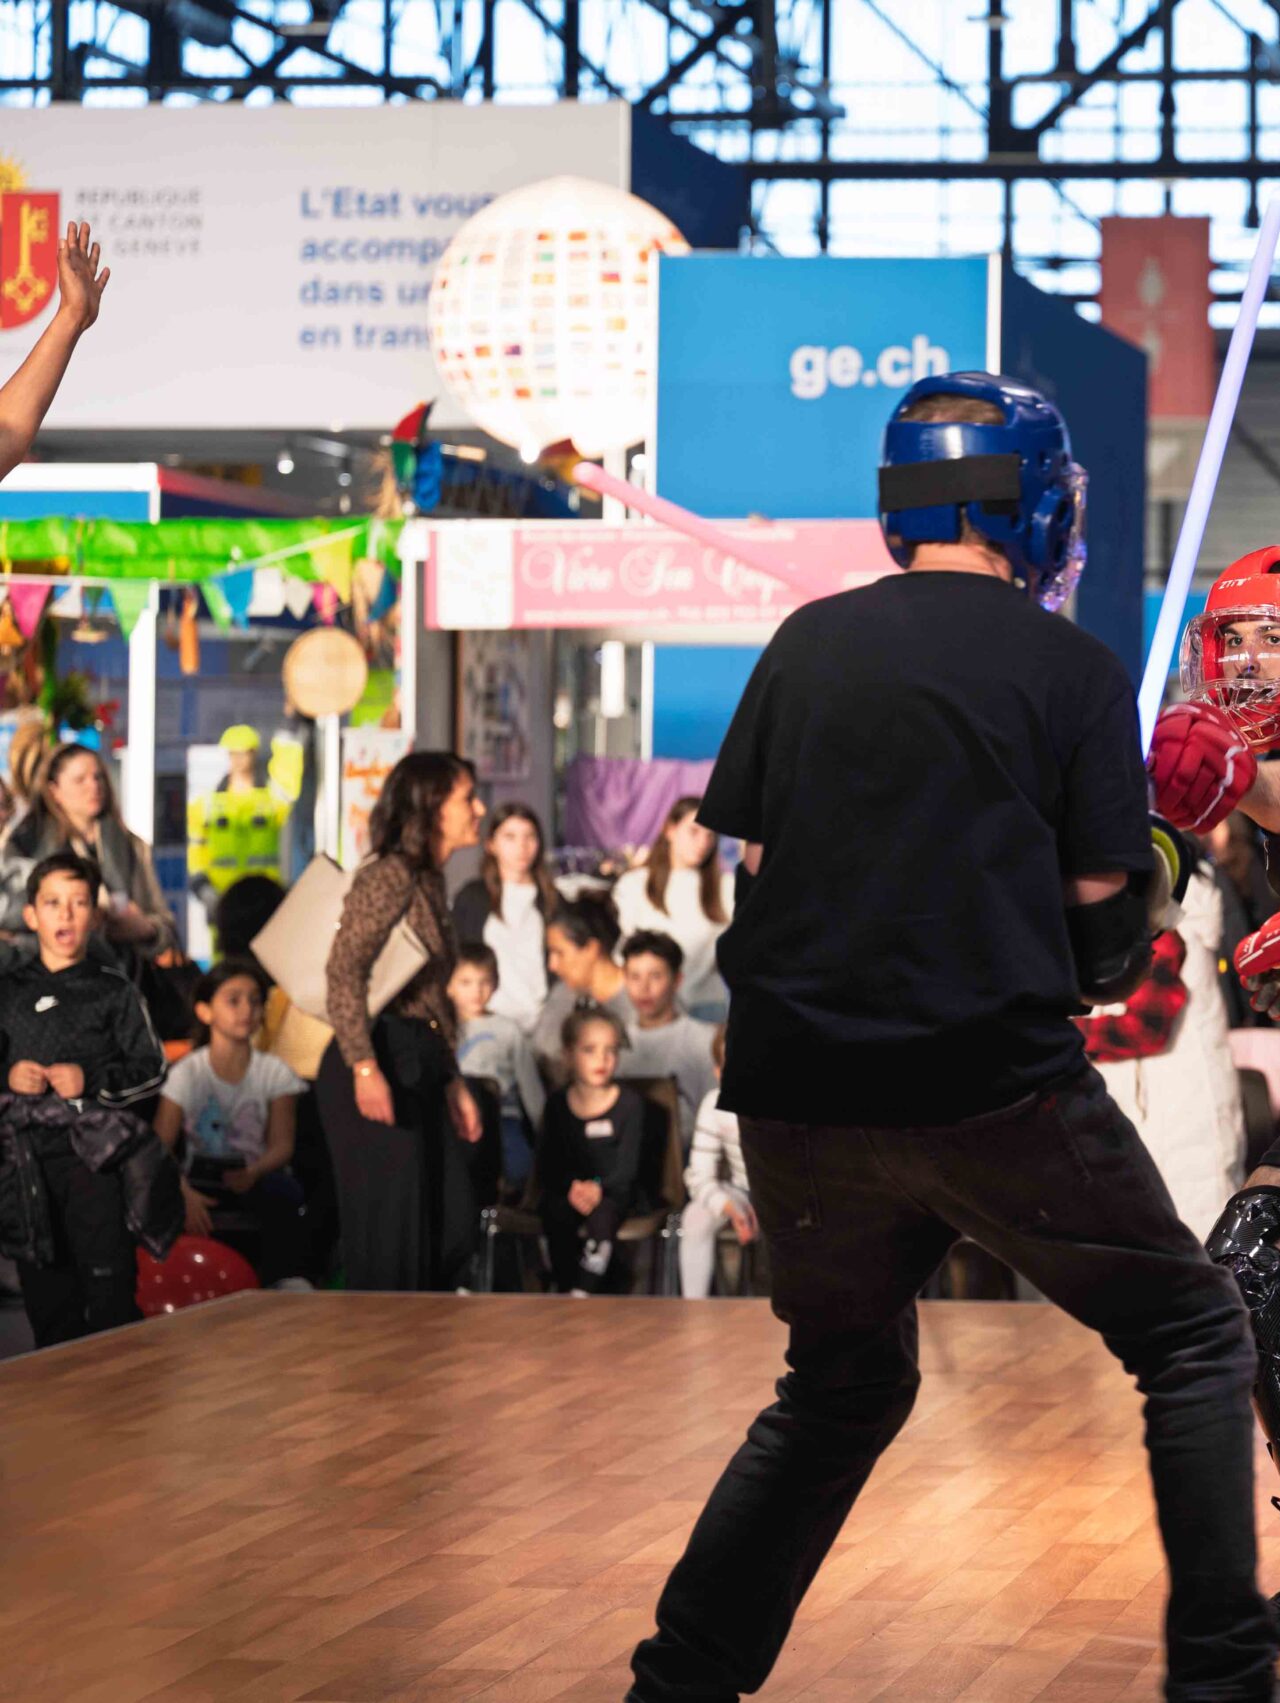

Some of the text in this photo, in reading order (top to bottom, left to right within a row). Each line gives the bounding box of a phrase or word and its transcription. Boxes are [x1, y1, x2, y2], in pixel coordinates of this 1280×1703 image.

[301, 186, 401, 218] L'Etat
[301, 237, 453, 268] accomp
[301, 274, 384, 305] dans
[301, 323, 342, 348] en
[790, 334, 950, 399] ge.ch
